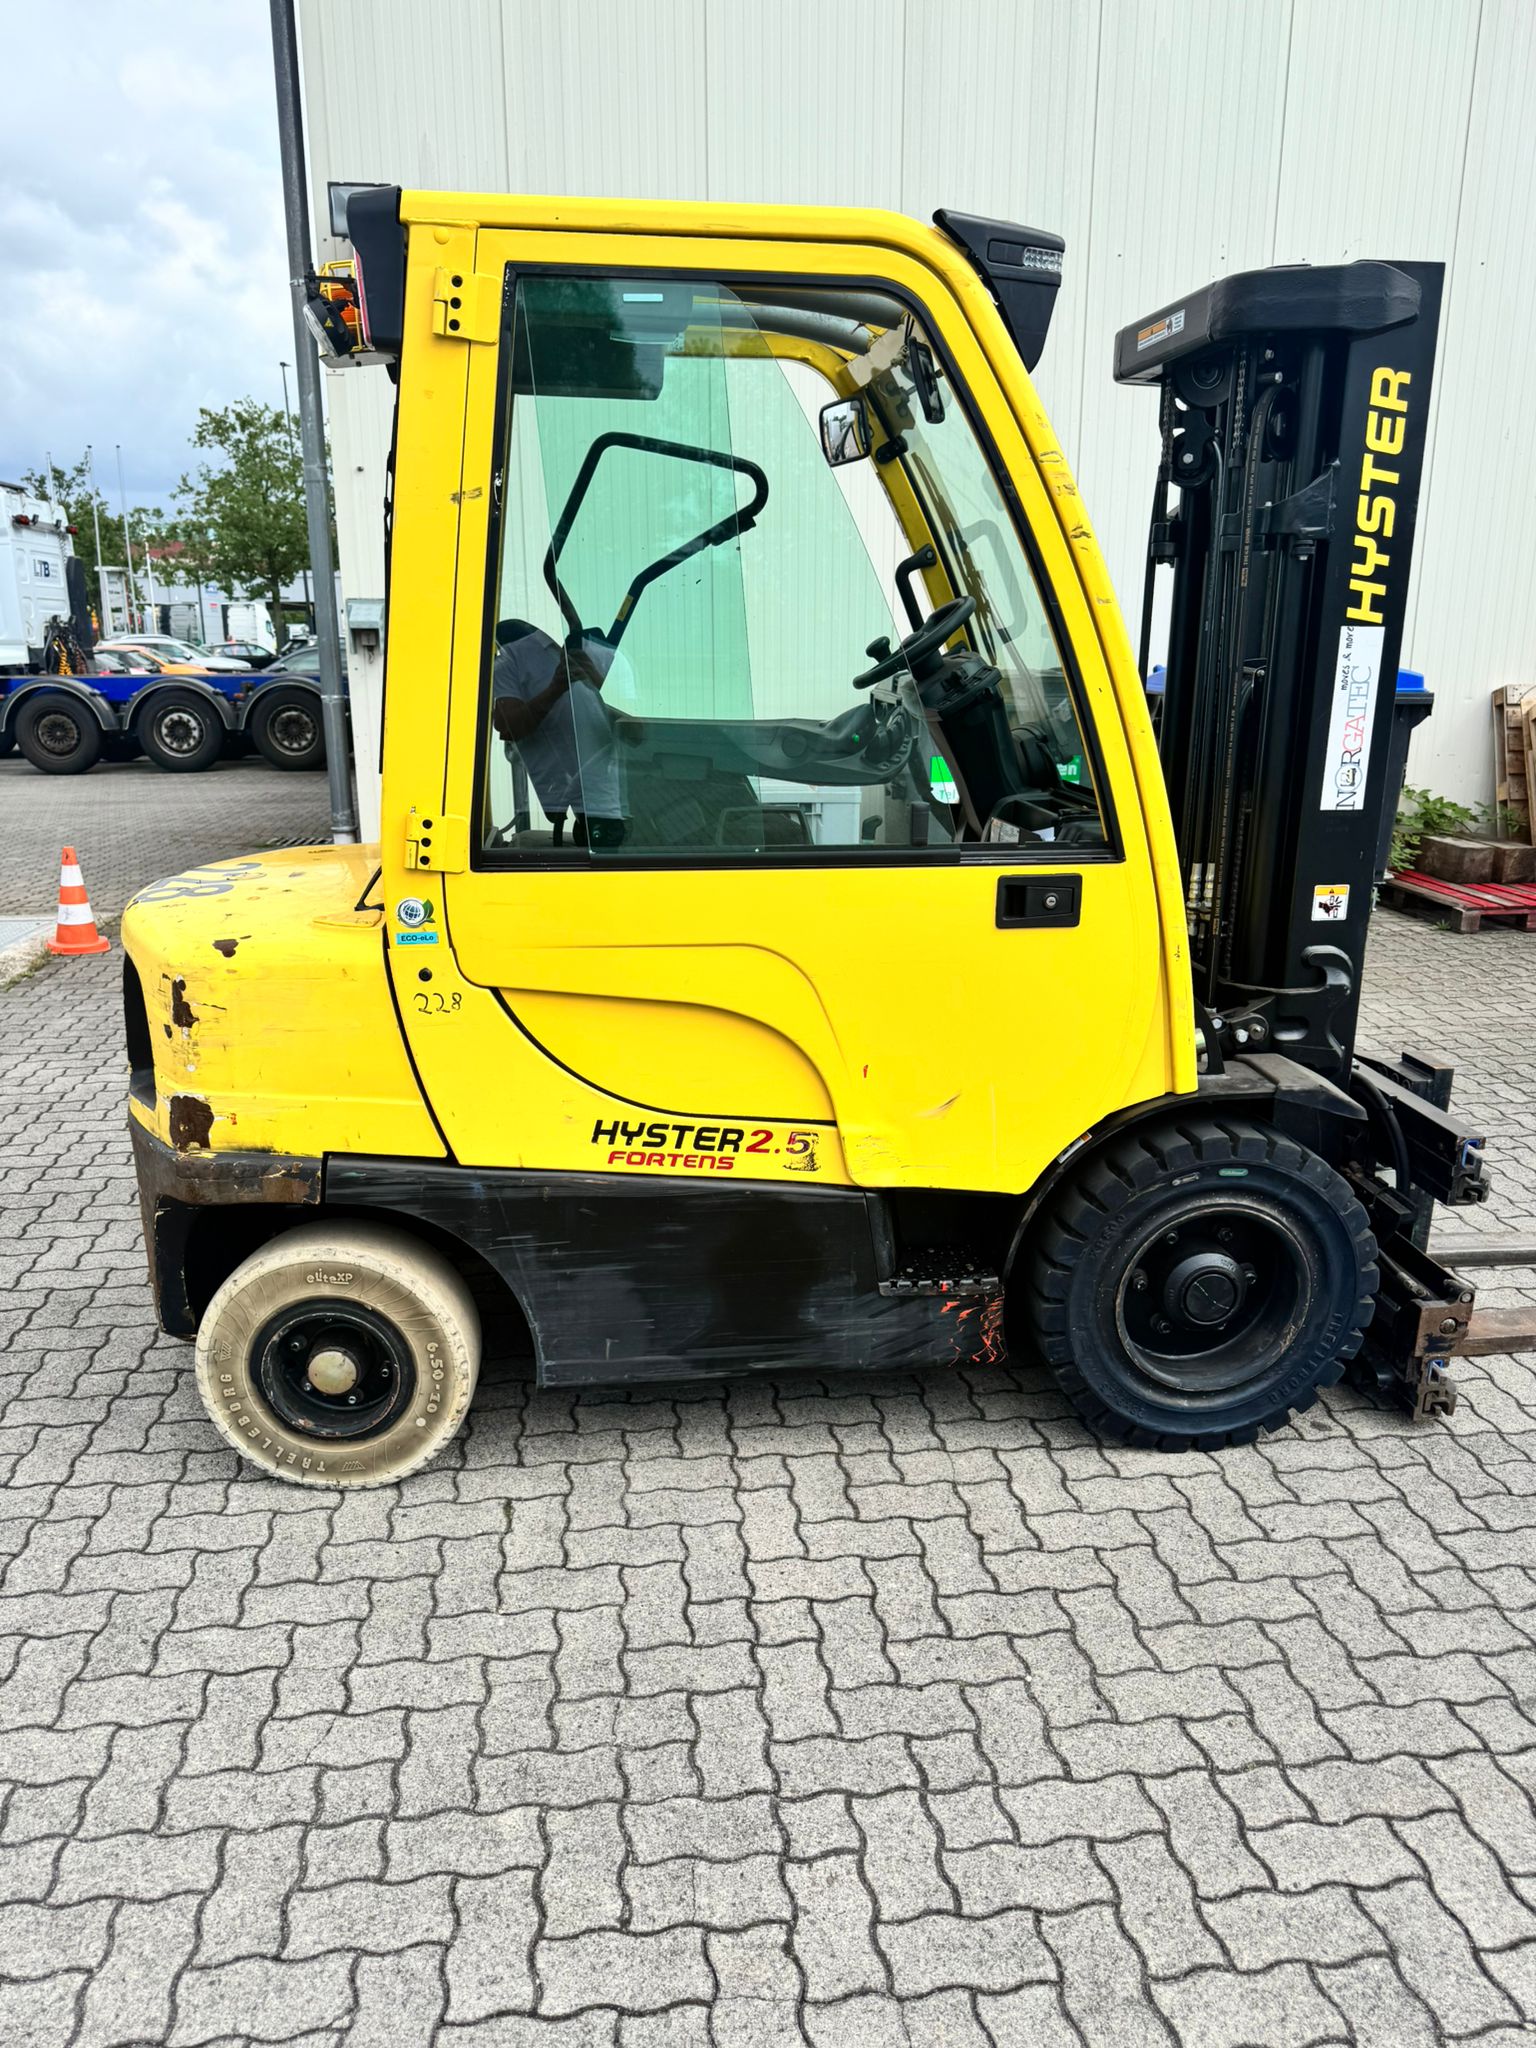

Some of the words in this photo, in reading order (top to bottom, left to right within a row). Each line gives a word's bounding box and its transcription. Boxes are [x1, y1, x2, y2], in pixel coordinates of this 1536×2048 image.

[1347, 366, 1412, 624] HYSTER
[1345, 626, 1355, 650] more
[1340, 665, 1351, 691] moves
[414, 992, 463, 1015] 228
[591, 1119, 744, 1153] HYSTER
[745, 1129, 814, 1155] 2.5
[607, 1151, 735, 1170] FORTENS
[219, 1373, 326, 1473] TRELLEBORG
